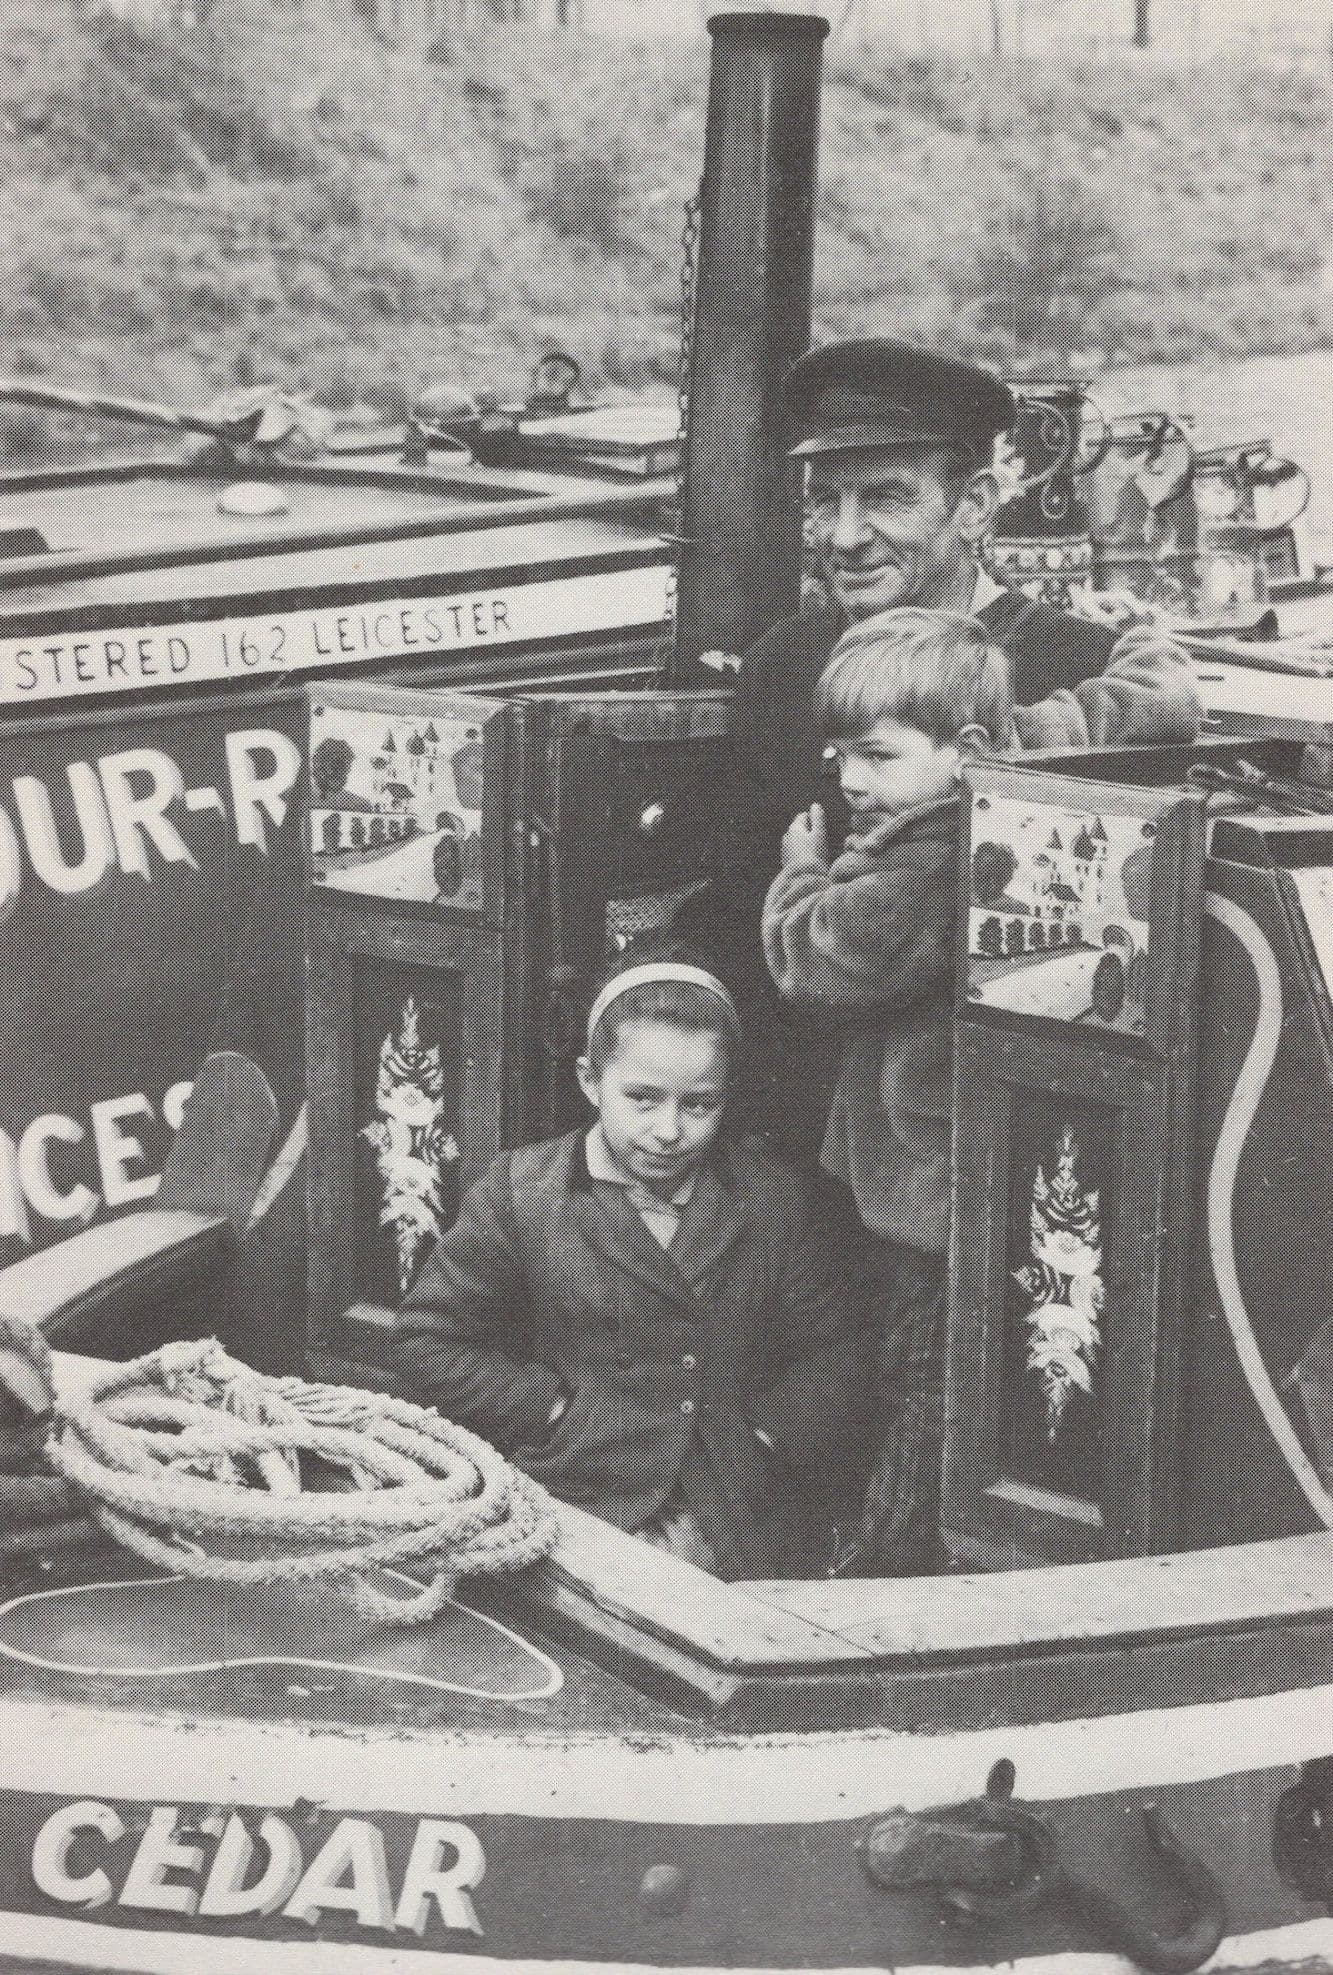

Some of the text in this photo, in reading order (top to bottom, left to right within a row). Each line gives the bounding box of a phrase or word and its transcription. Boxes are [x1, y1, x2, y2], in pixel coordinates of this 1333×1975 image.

[15, 600, 513, 690] STERED 162 LEICESTER
[0, 728, 301, 918] UR-R
[32, 1800, 486, 1936] CEDAR
